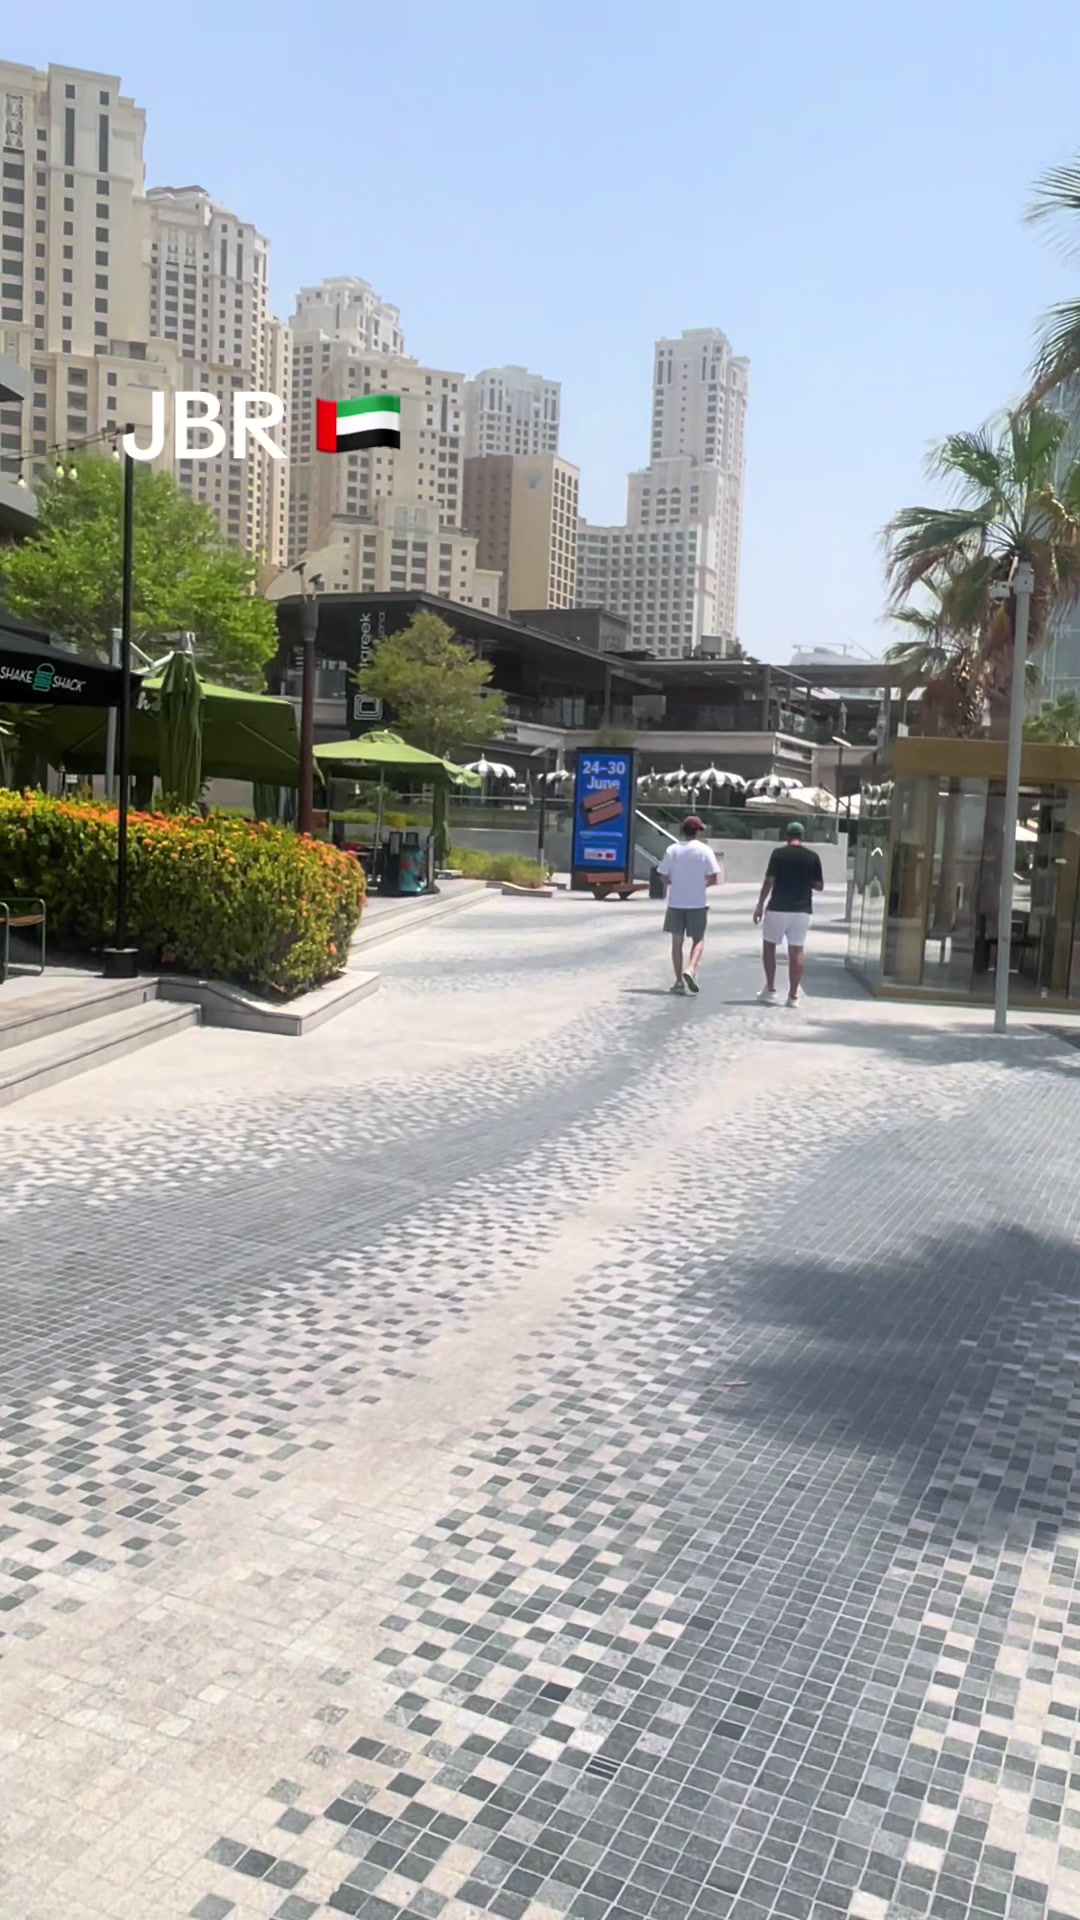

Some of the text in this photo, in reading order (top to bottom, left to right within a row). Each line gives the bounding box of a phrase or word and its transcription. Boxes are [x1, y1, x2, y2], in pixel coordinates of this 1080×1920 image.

[0, 666, 86, 692] SHAKE SHACK
[586, 776, 620, 790] June
